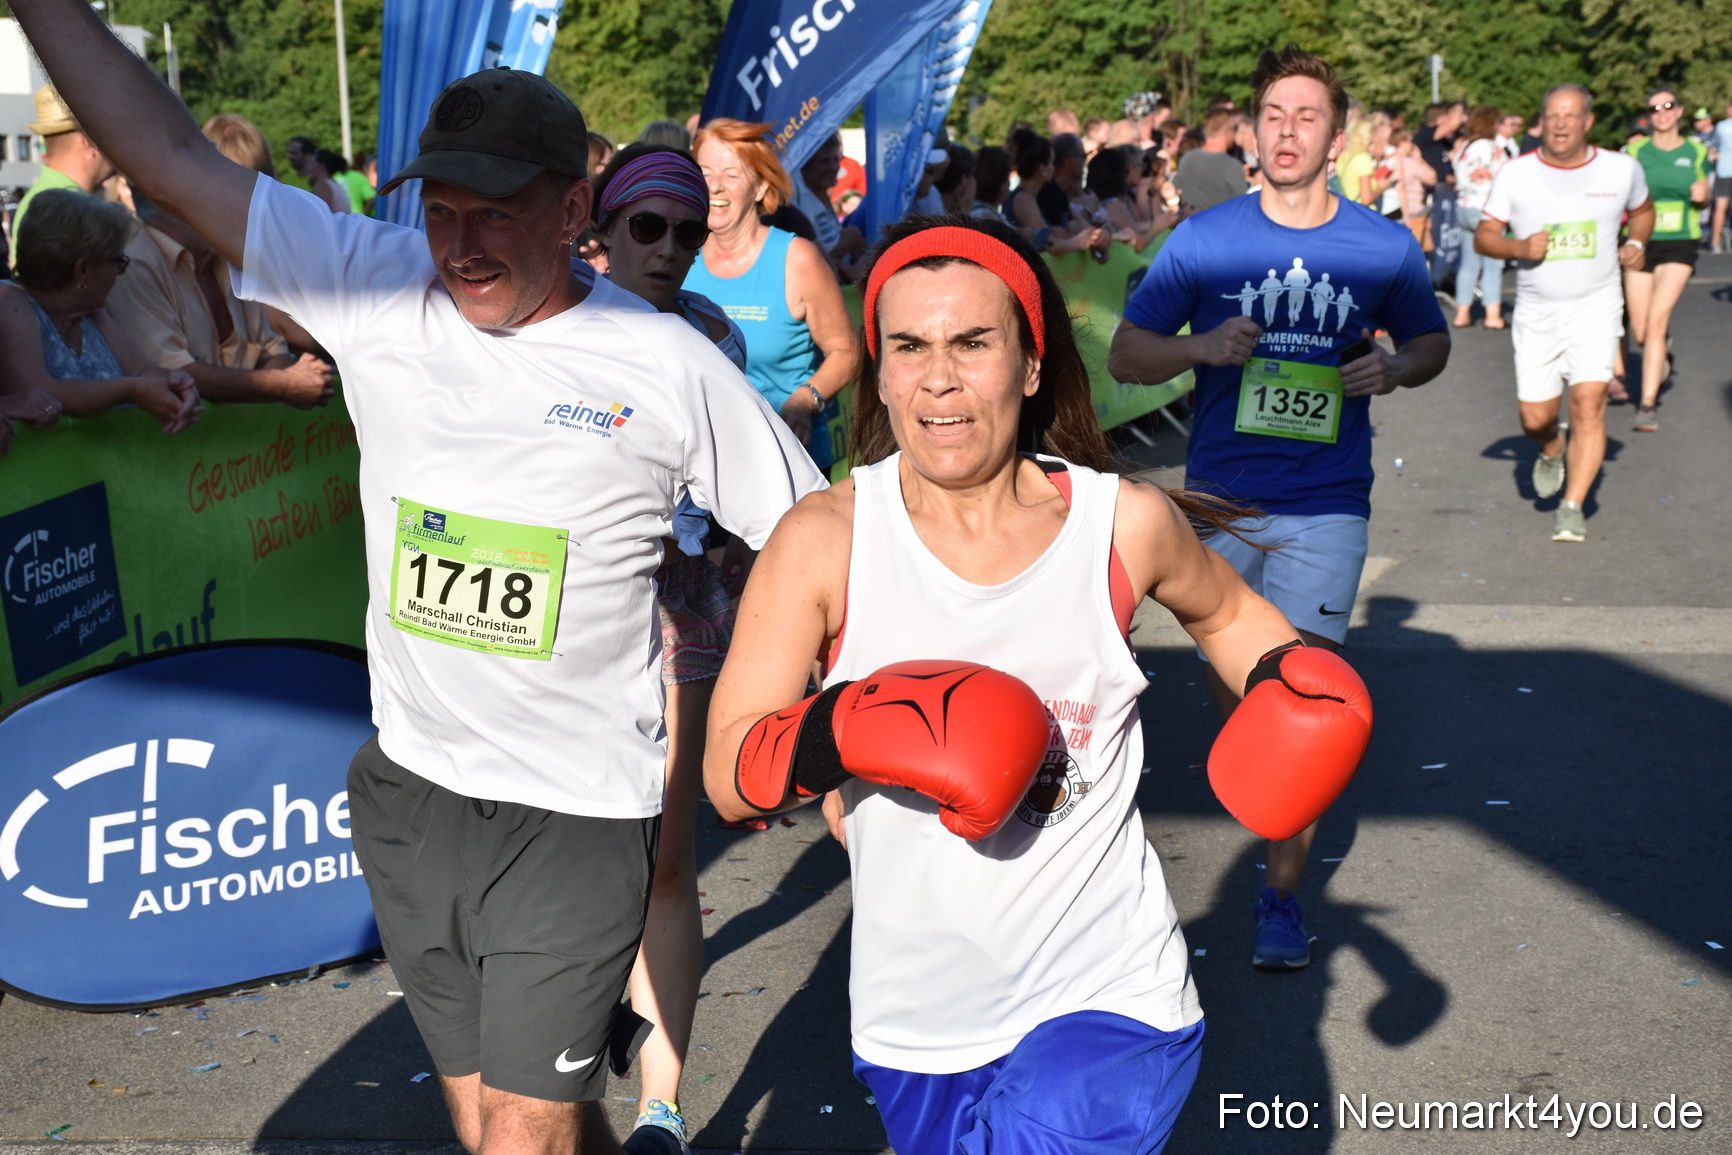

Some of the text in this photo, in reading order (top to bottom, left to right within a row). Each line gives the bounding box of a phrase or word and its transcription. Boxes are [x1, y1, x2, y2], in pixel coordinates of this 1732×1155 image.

[736, 0, 856, 112] Frisc
[1257, 332, 1333, 348] EMEINSAM
[547, 400, 615, 430] reindl
[1254, 385, 1329, 420] 1352
[559, 419, 583, 431] Wärme
[587, 426, 612, 438] Energie
[1255, 413, 1321, 428] Leuchtmann Alex
[323, 475, 361, 525] län
[413, 523, 467, 546] firmenlauf
[23, 543, 97, 592] Fischer
[470, 548, 503, 561] 2018
[34, 570, 96, 607] AUTOMOBILE
[410, 552, 533, 620] 1718
[399, 609, 420, 624] Reindl
[422, 618, 437, 628] Bad
[439, 622, 468, 636] Wärme
[470, 630, 504, 644] Energie
[507, 635, 536, 647] GmbH
[407, 599, 462, 624] Marschall
[466, 615, 527, 635] Christian
[1067, 728, 1092, 750] TEAM
[88, 783, 353, 884] Fische
[1035, 814, 1054, 826] GUTE
[129, 851, 364, 920] AUTOMOBIL
